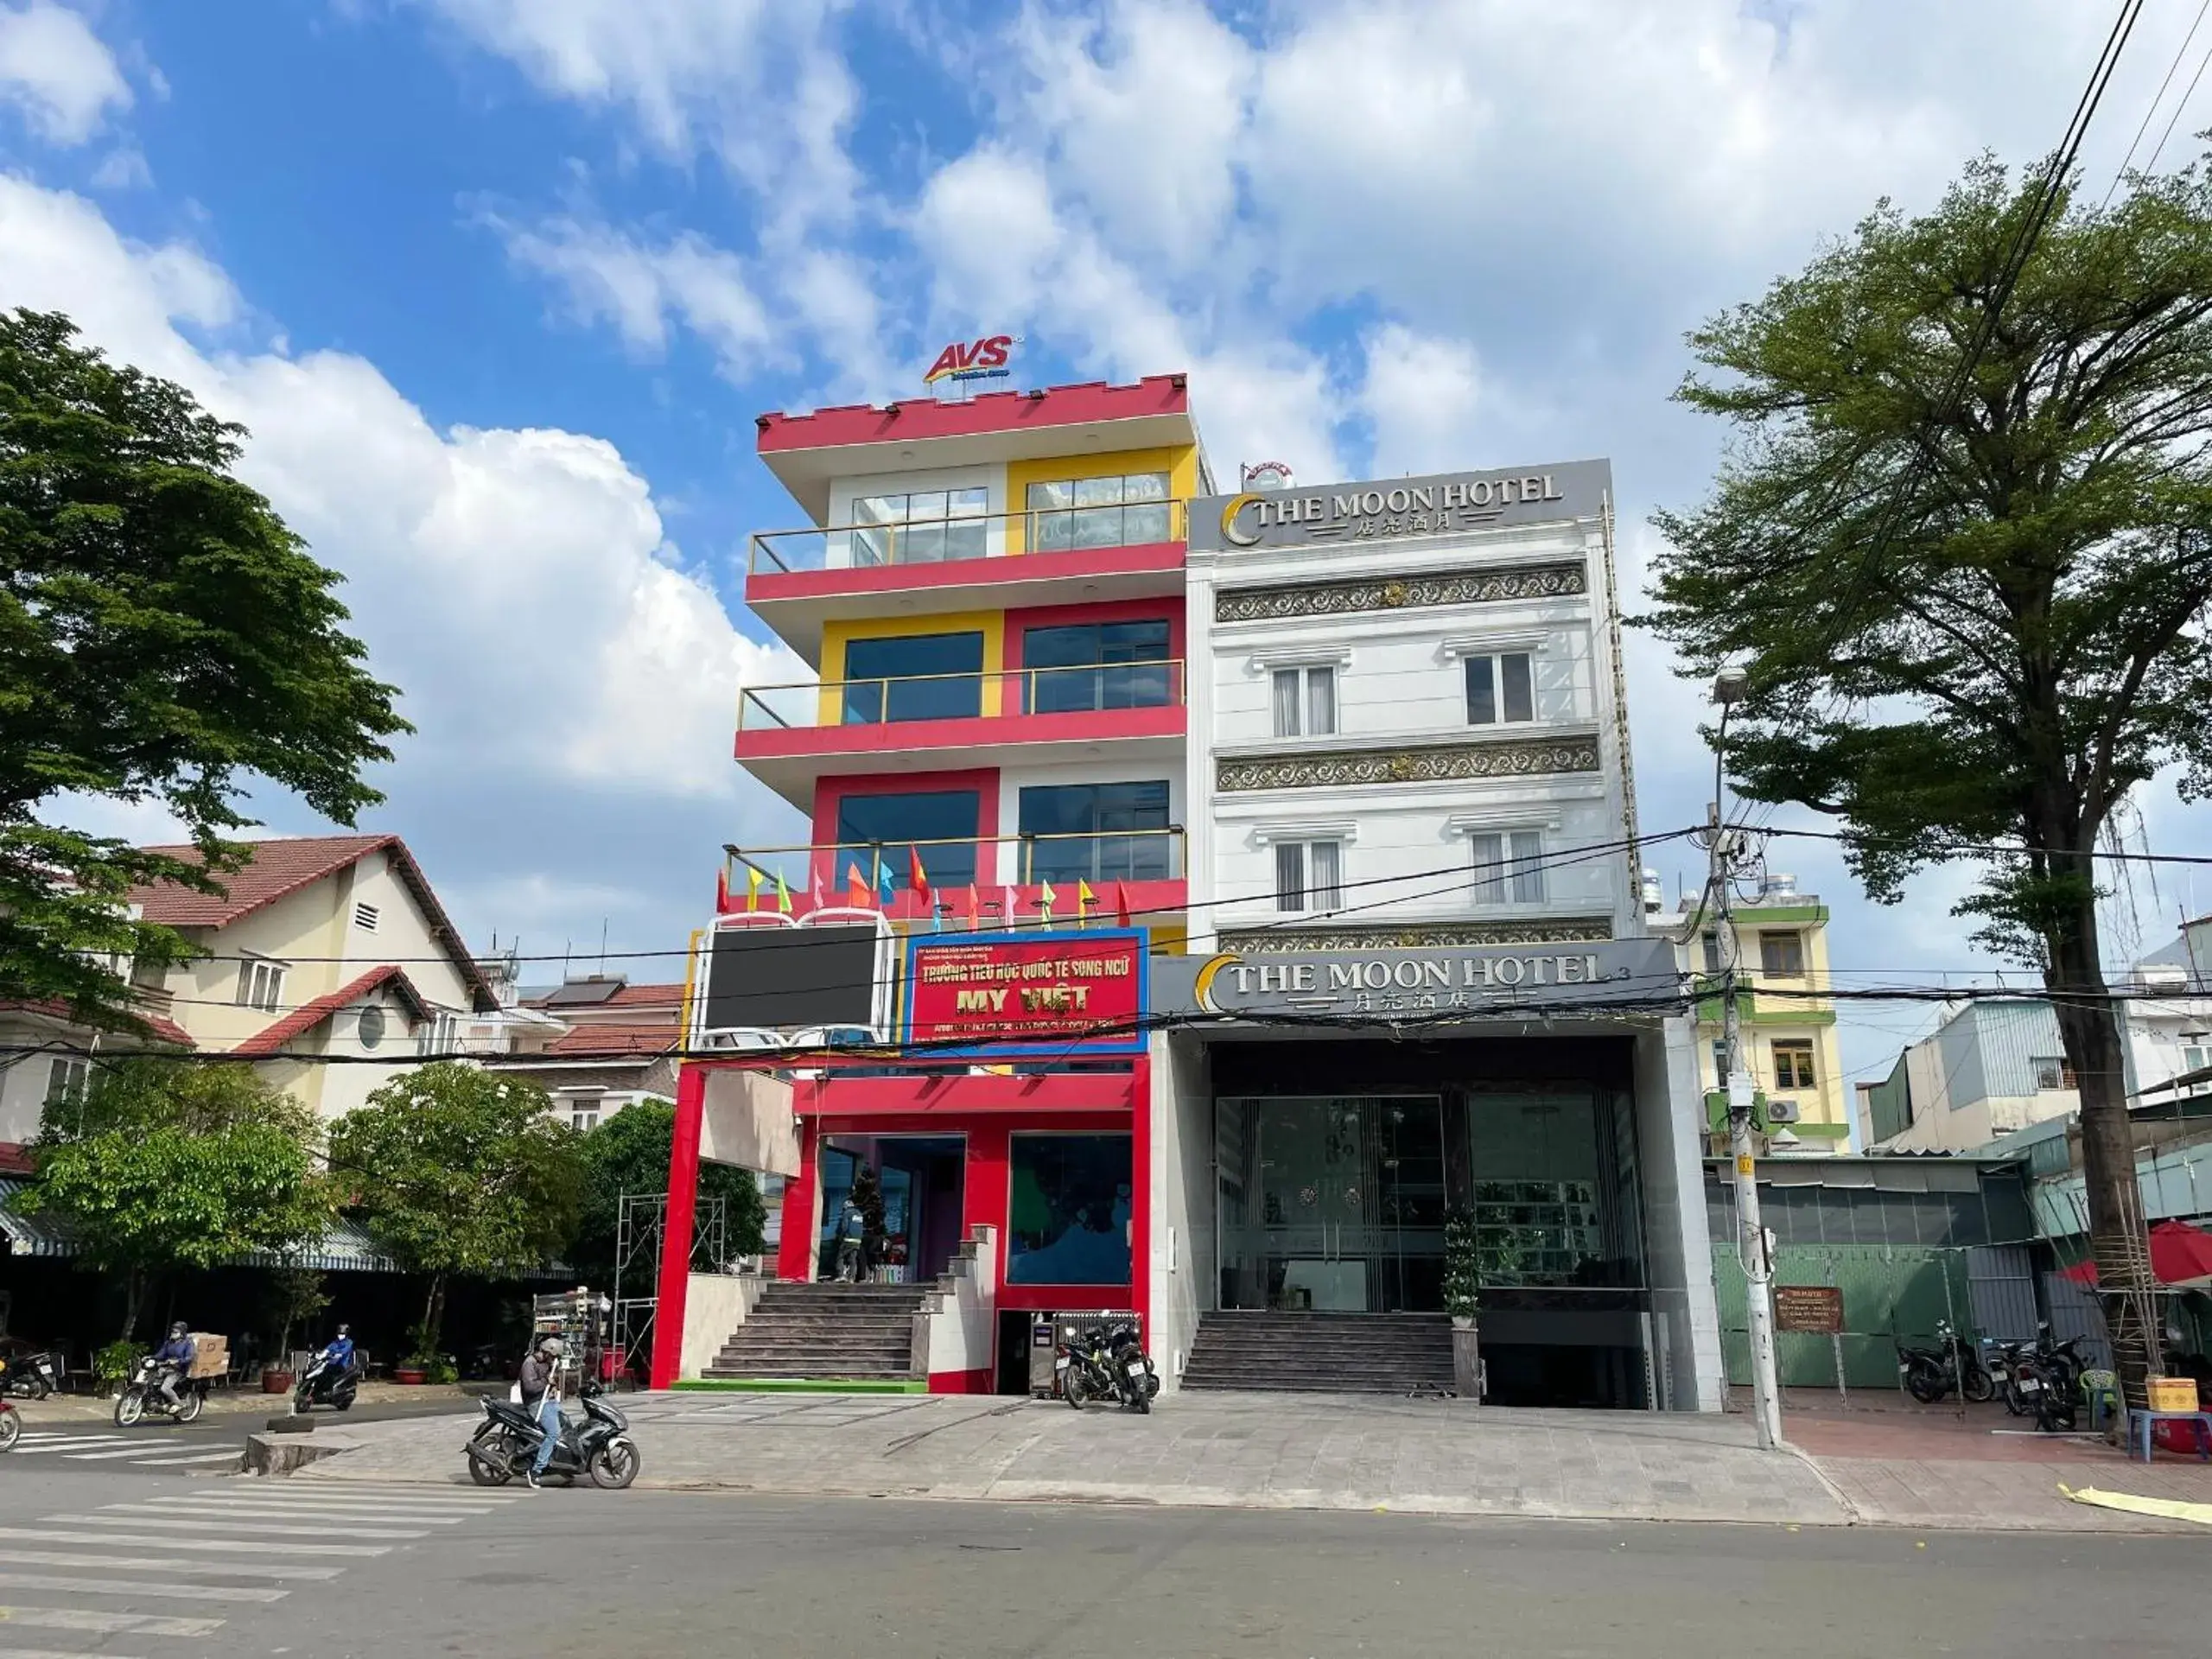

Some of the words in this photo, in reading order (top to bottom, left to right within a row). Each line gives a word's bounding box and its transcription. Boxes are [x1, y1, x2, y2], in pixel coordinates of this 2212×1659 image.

[925, 335, 1012, 380] AVS
[1253, 496, 1325, 528] THE
[1332, 486, 1435, 520] MOON
[1442, 474, 1565, 510] HOTEL
[1071, 959, 1102, 977] SONG
[1104, 956, 1130, 976] NGỮ
[1231, 964, 1316, 993] THE
[1326, 958, 1453, 991] MOON
[1464, 954, 1607, 988] HOTEL
